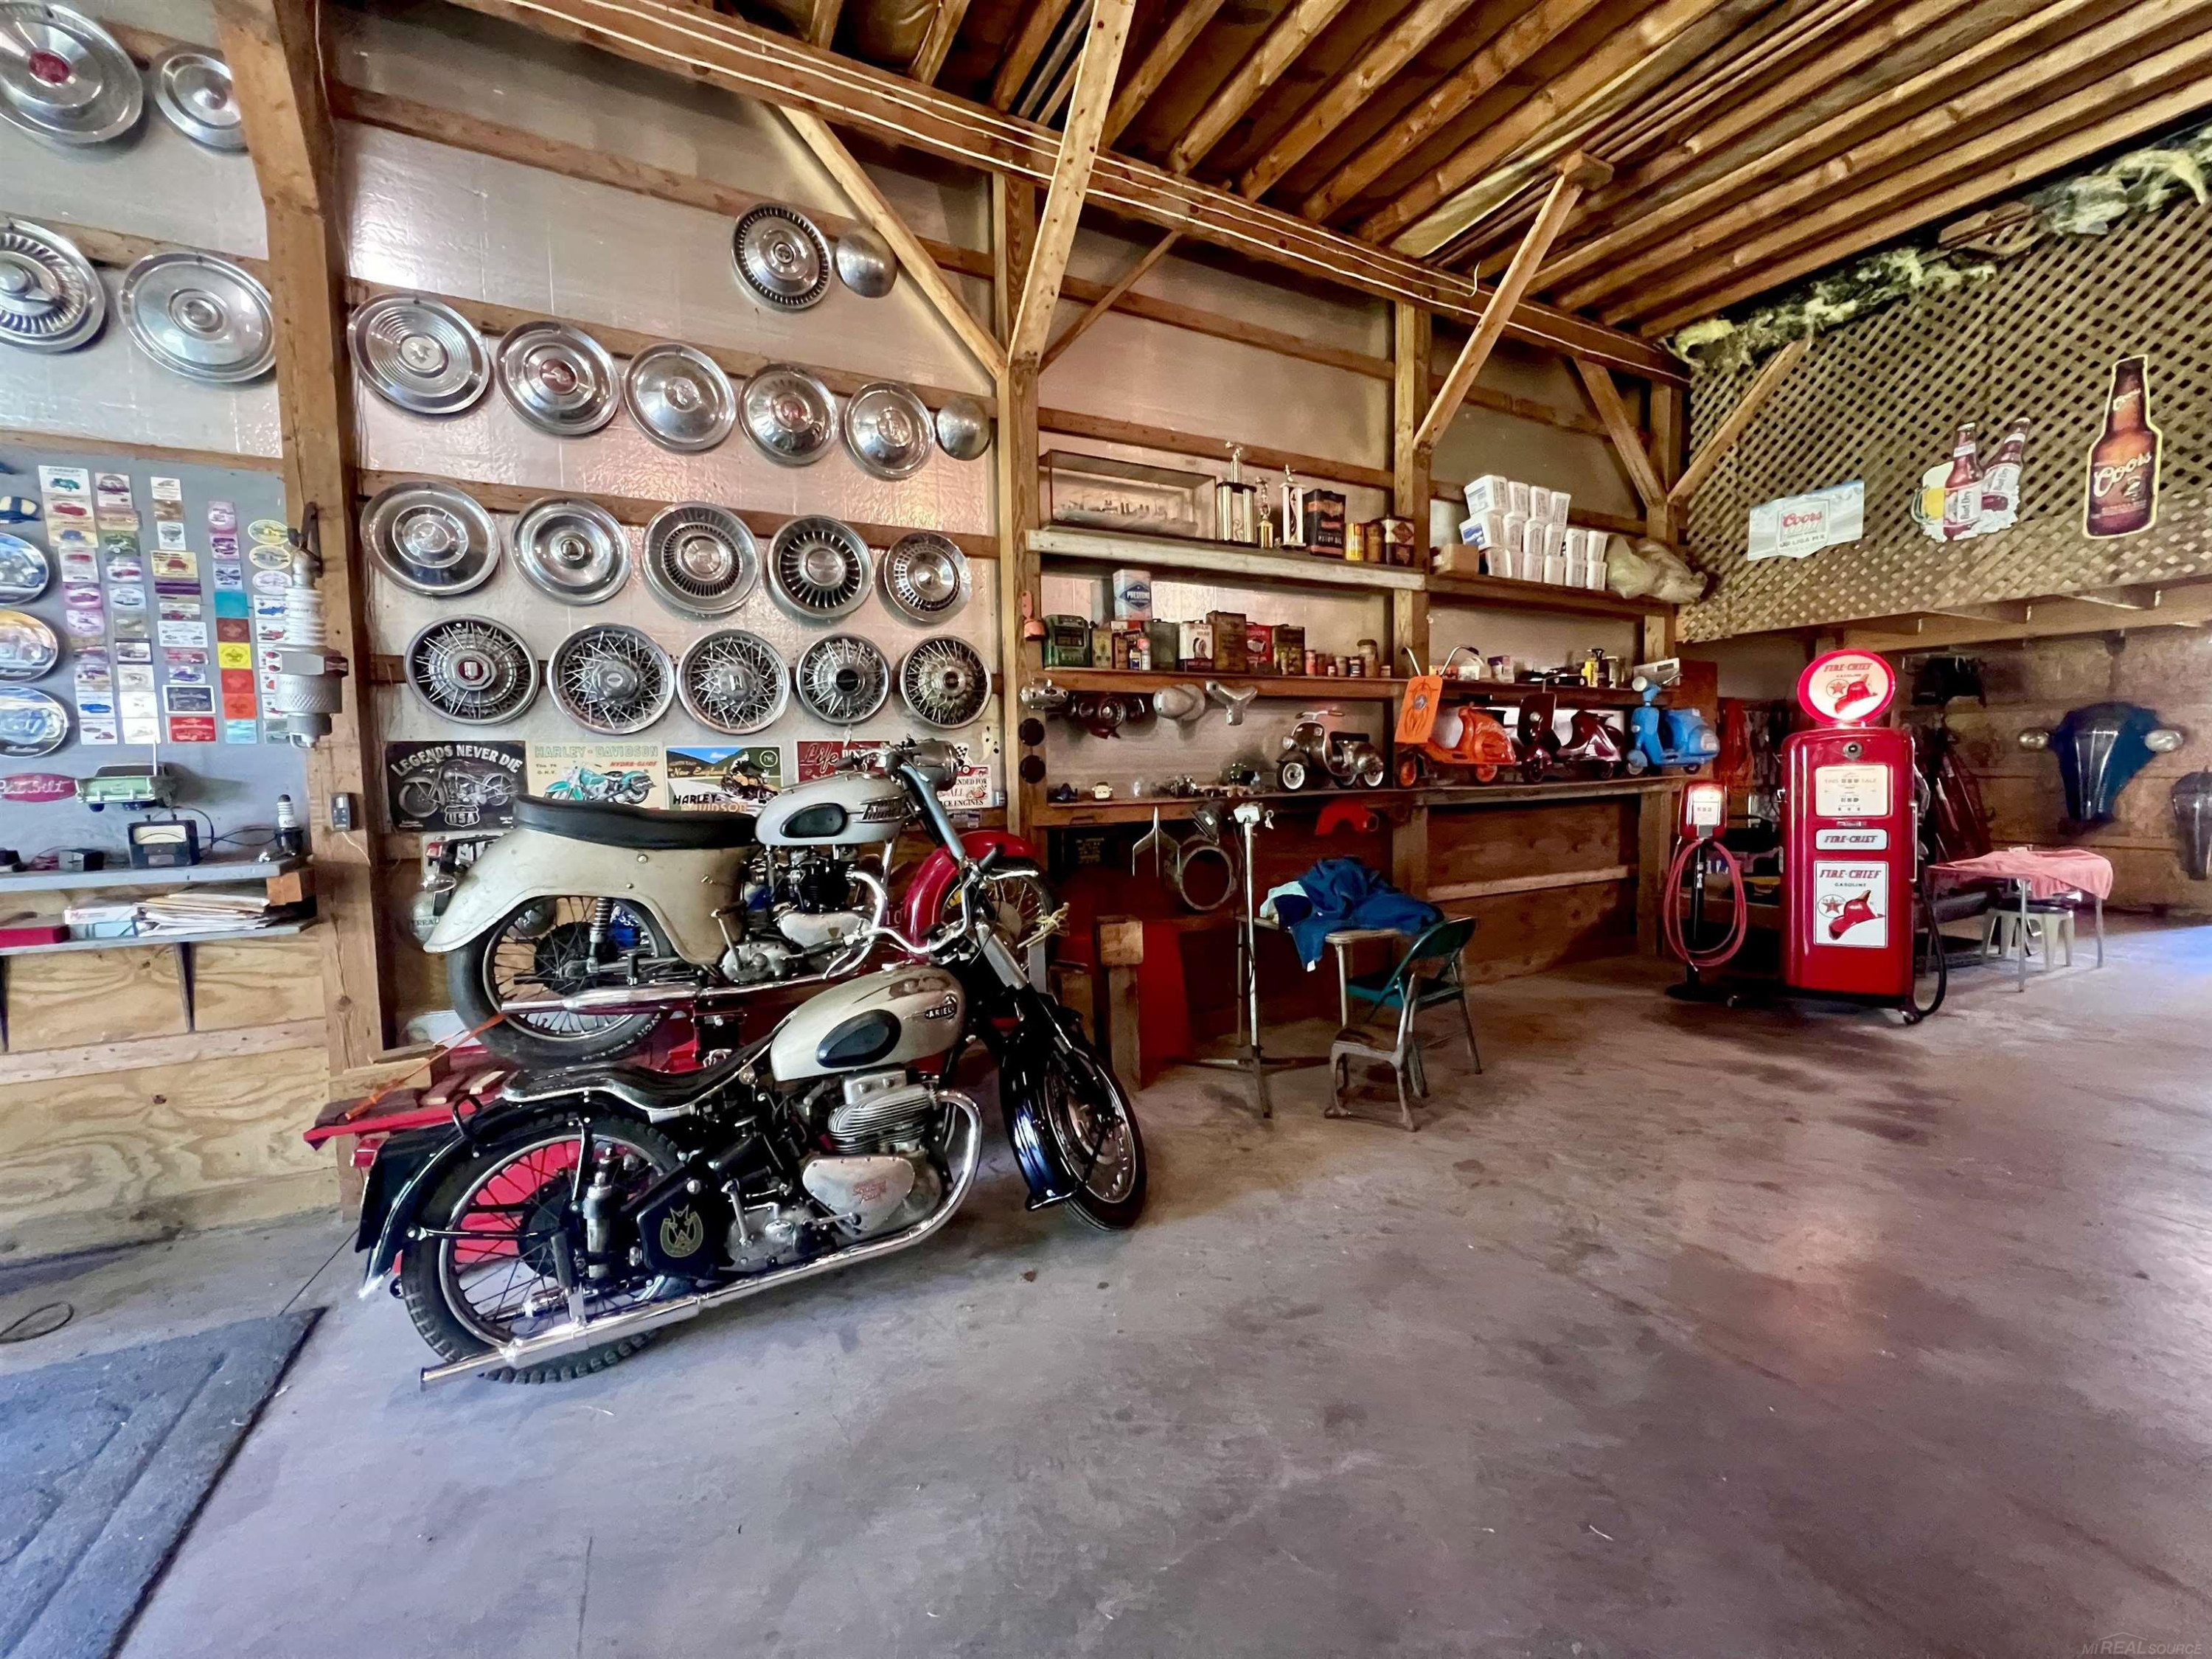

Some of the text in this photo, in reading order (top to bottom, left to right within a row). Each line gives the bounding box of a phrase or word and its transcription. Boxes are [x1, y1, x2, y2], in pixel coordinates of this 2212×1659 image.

[2093, 451, 2152, 497] Coors
[1960, 505, 1970, 519] Bud
[1783, 511, 1823, 527] Coors
[1823, 663, 1873, 672] FIRE-CHIEF
[535, 745, 658, 758] HARLEY DAVIDSON
[799, 742, 839, 774] Life
[391, 744, 523, 777] LEGENDS NEVER DIE
[673, 794, 721, 804] HARLEY-
[448, 813, 476, 824] USA
[1820, 869, 1882, 878] FIRE-CHIEF
[929, 1007, 952, 1018] ARIEL
